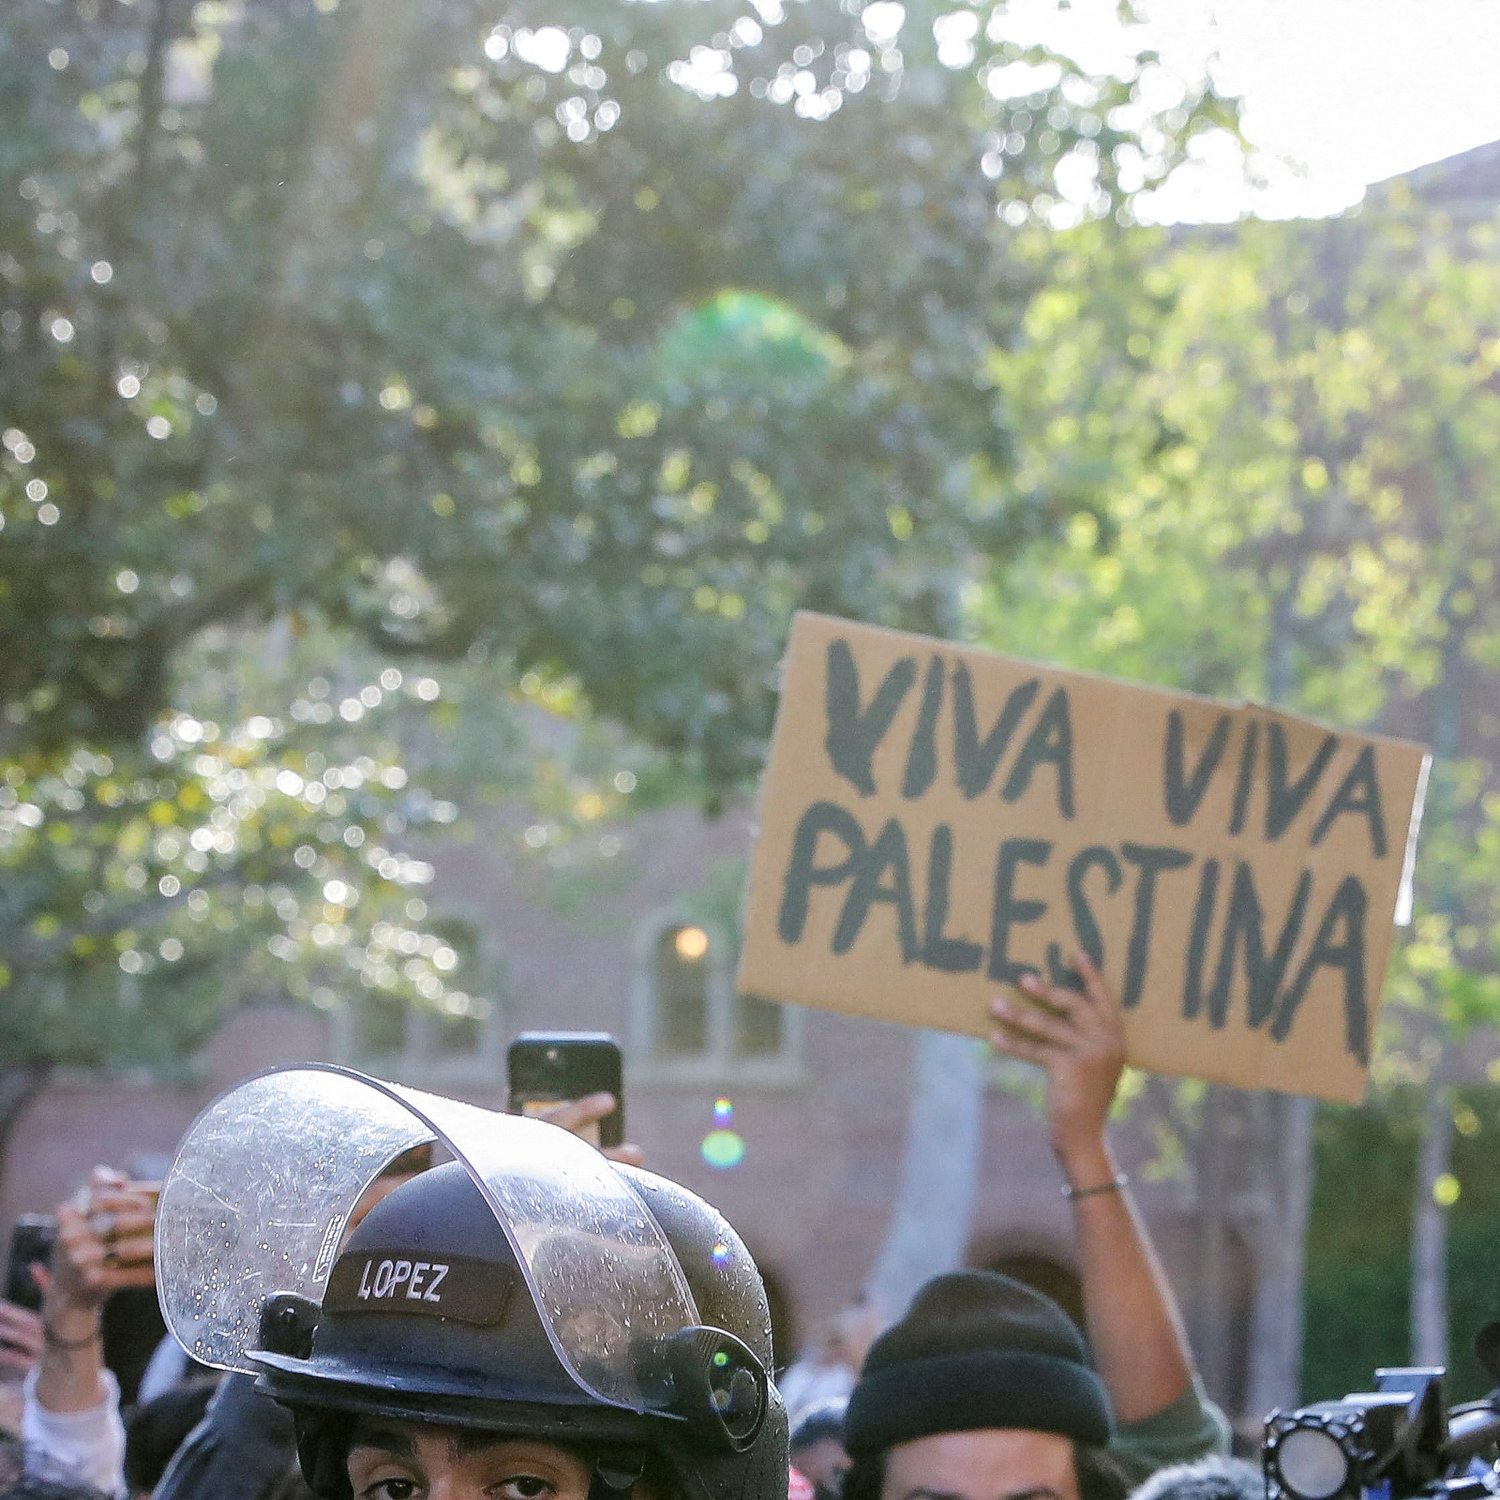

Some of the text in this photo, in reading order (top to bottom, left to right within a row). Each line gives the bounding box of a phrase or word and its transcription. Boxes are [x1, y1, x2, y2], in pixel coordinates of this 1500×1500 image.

[825, 637, 1389, 858] VIVA VIVA
[776, 800, 1370, 1066] PALESTINA
[357, 1259, 450, 1303] LOPEZ
